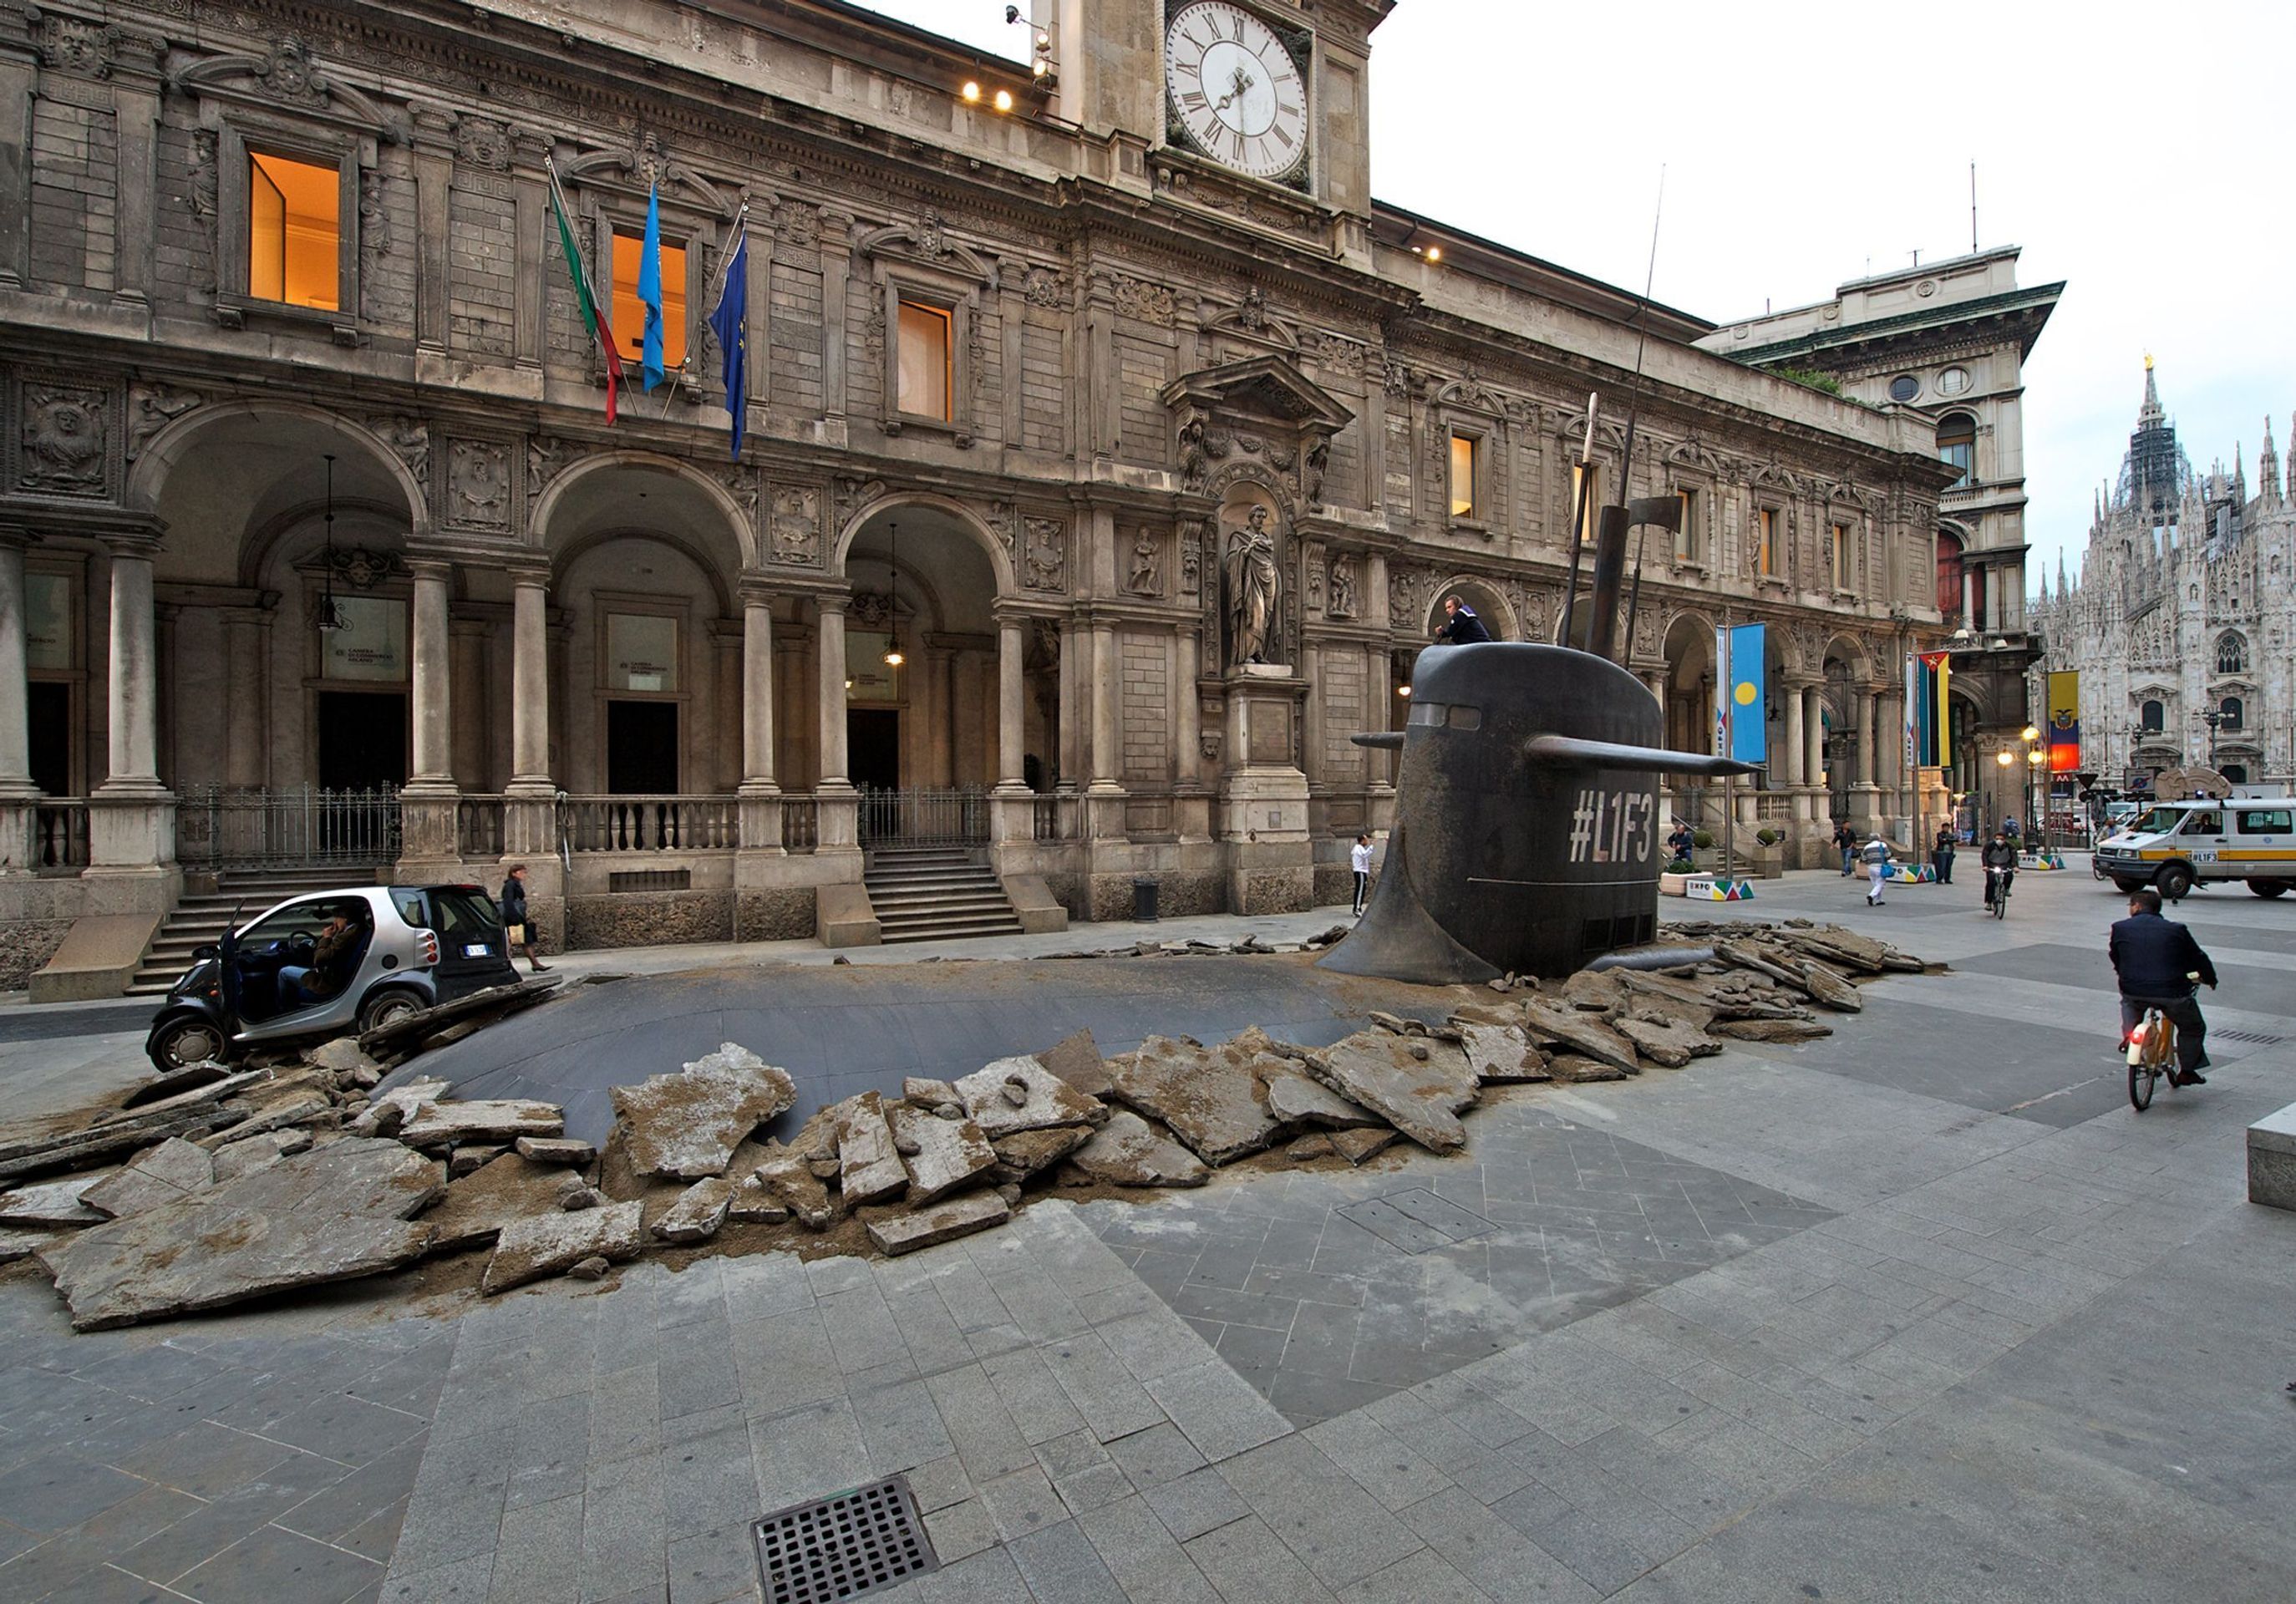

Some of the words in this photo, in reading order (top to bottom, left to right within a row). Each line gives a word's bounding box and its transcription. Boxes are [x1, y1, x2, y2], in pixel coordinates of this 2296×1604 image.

[1181, 28, 1205, 53] X
[1570, 789, 1653, 862] #L1F3
[2193, 853, 2217, 862] #L1F3
